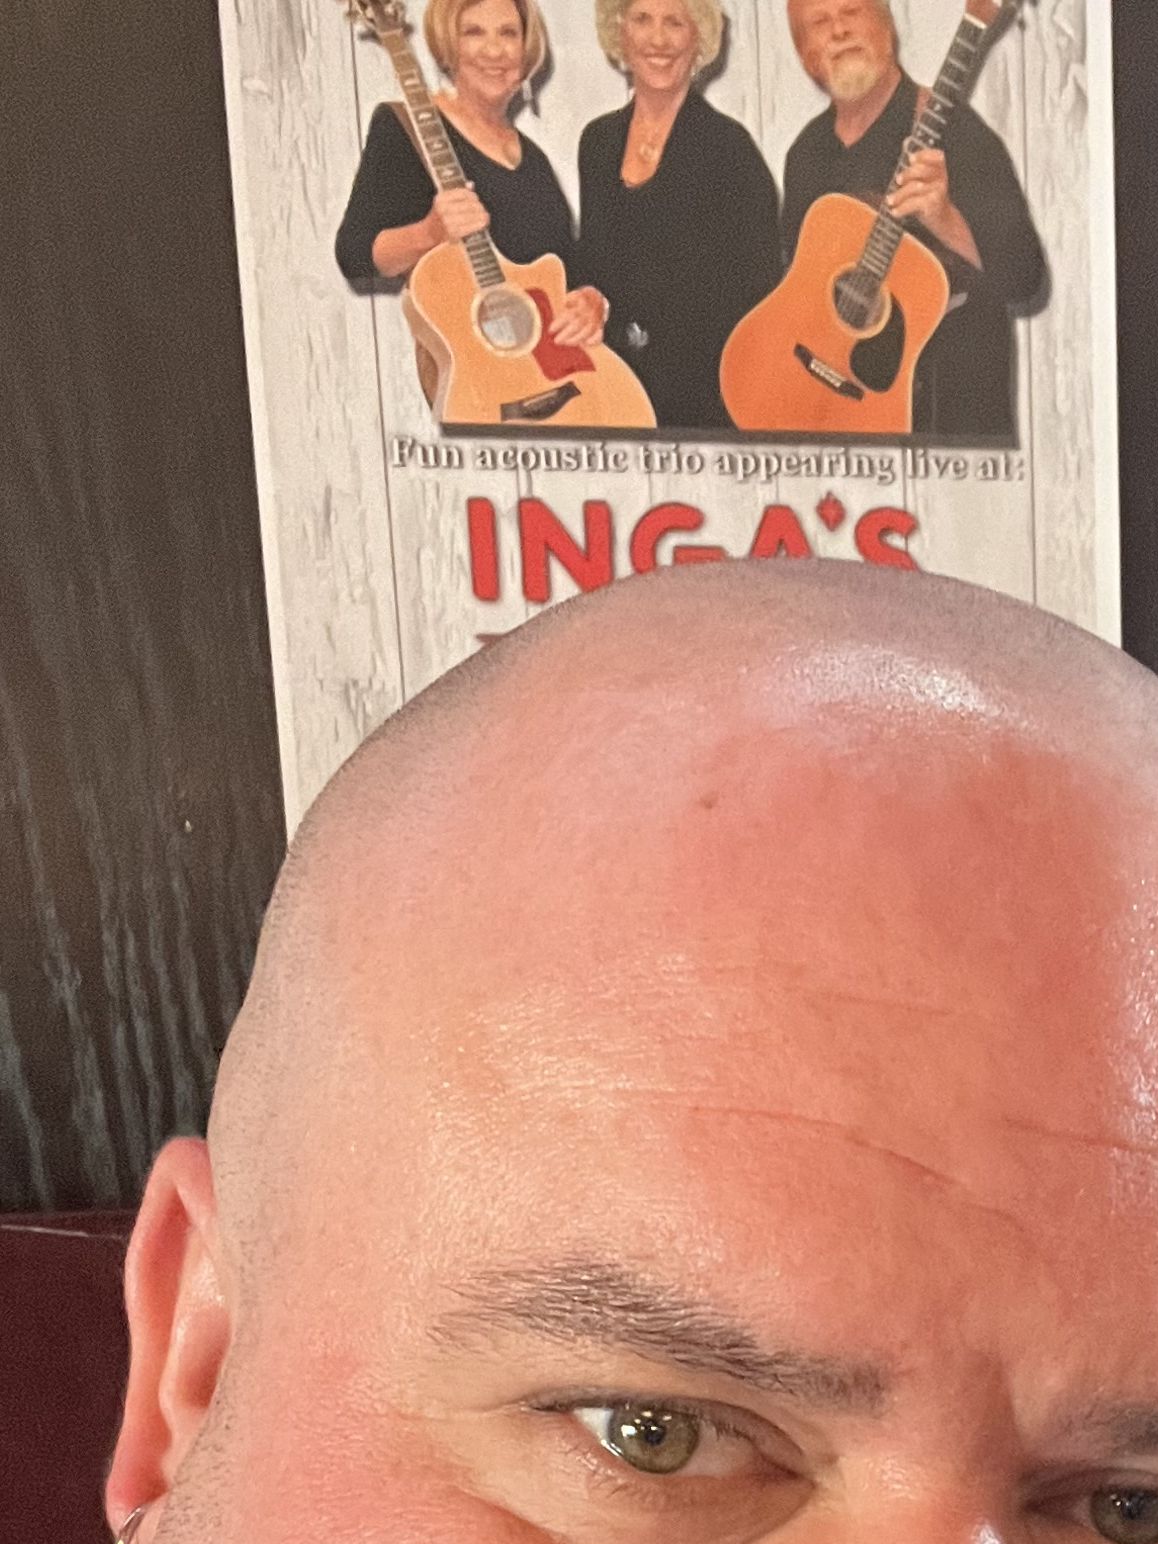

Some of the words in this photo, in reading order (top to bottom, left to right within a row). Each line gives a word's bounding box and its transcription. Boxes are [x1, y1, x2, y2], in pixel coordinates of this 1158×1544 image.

[392, 437, 463, 470] Fun
[475, 441, 628, 473] acoustic
[639, 442, 706, 475] trio
[714, 446, 895, 486] appearing
[907, 447, 969, 480] live
[976, 452, 1026, 482] at:
